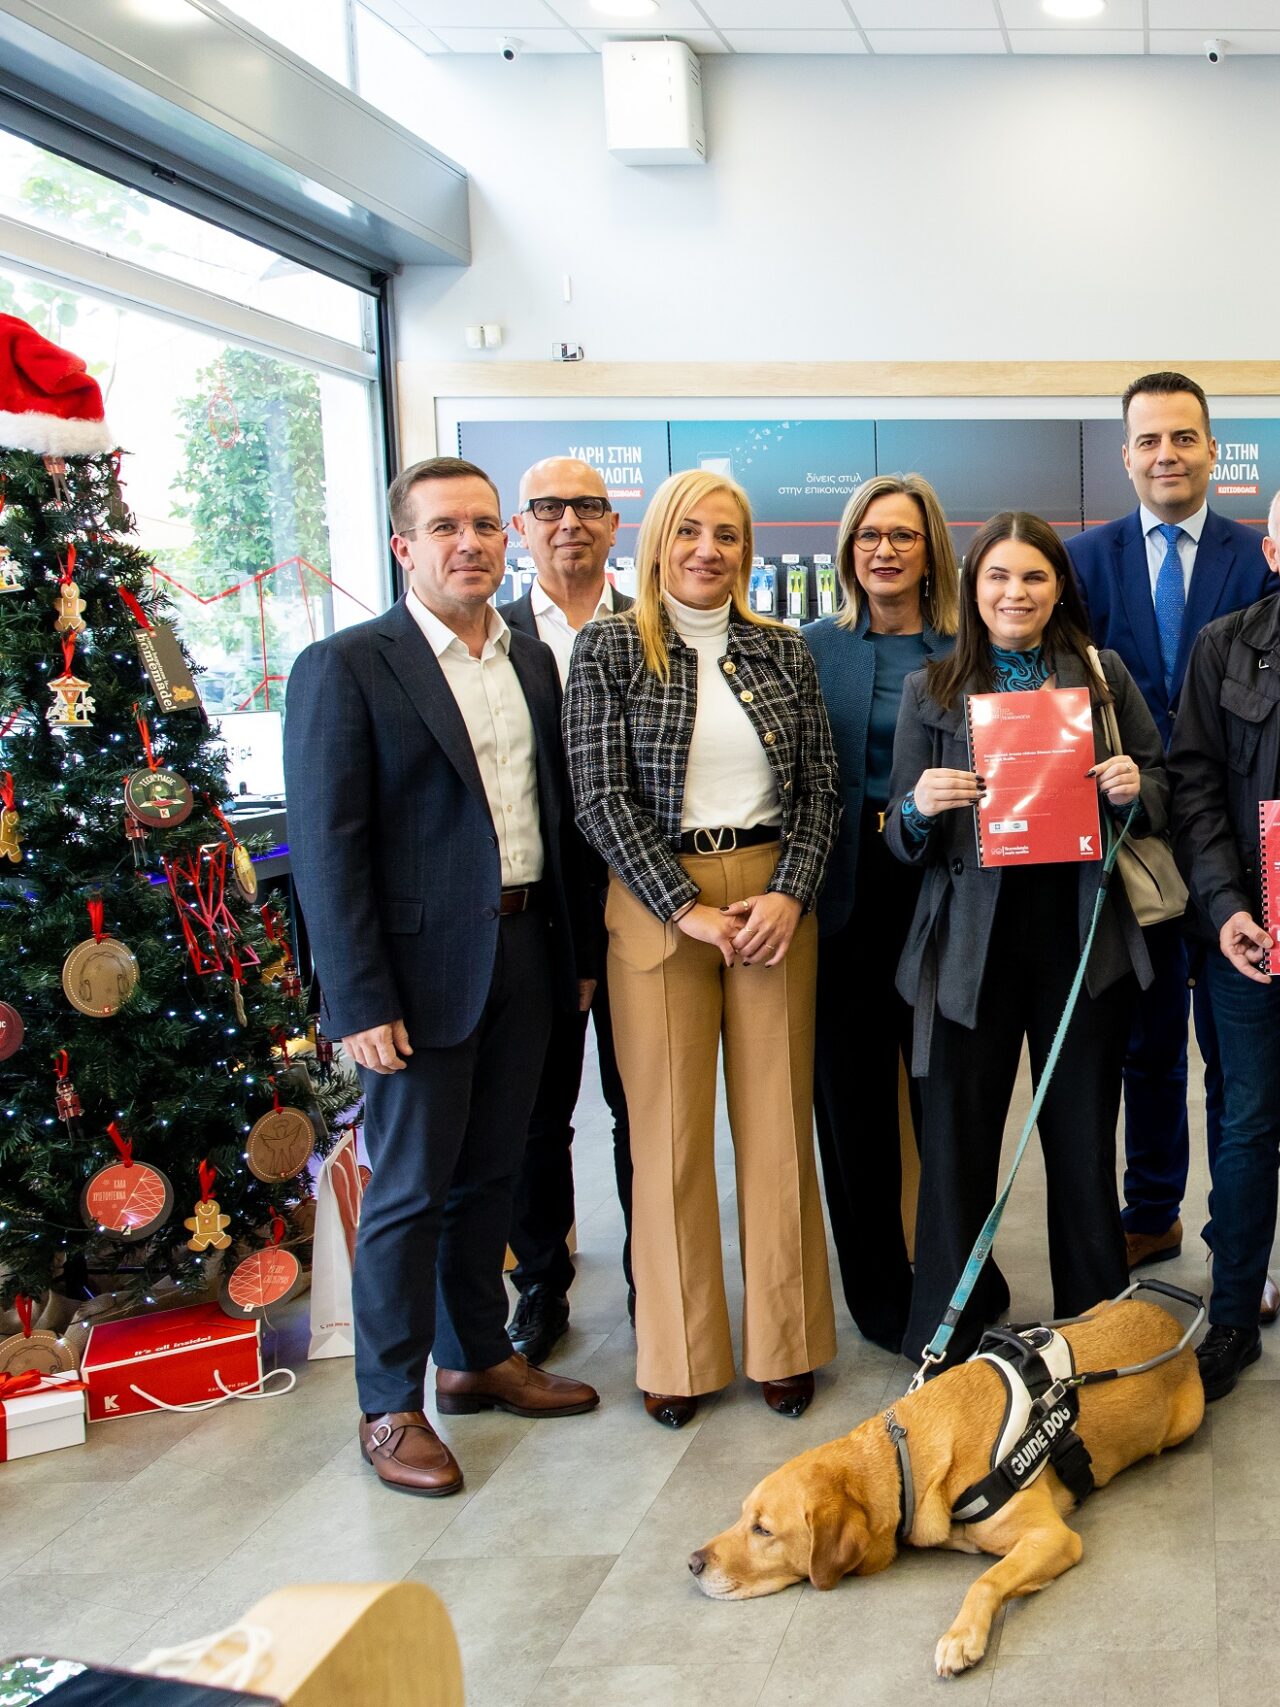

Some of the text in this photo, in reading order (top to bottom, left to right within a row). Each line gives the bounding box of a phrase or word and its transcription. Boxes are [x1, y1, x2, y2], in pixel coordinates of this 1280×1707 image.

[608, 447, 642, 463] ΣΤΗΝ
[1225, 443, 1259, 460] ΣΤΗΝ
[806, 472, 862, 484] δίνεις στυλ
[1209, 464, 1259, 480] ΟΛΟΓΙΑ
[778, 487, 801, 496] στην
[136, 632, 178, 711] homemade!
[1080, 835, 1094, 852] K
[155, 1344, 170, 1352] all
[104, 1394, 120, 1410] K
[1011, 1408, 1071, 1476] GUIDE DOG
